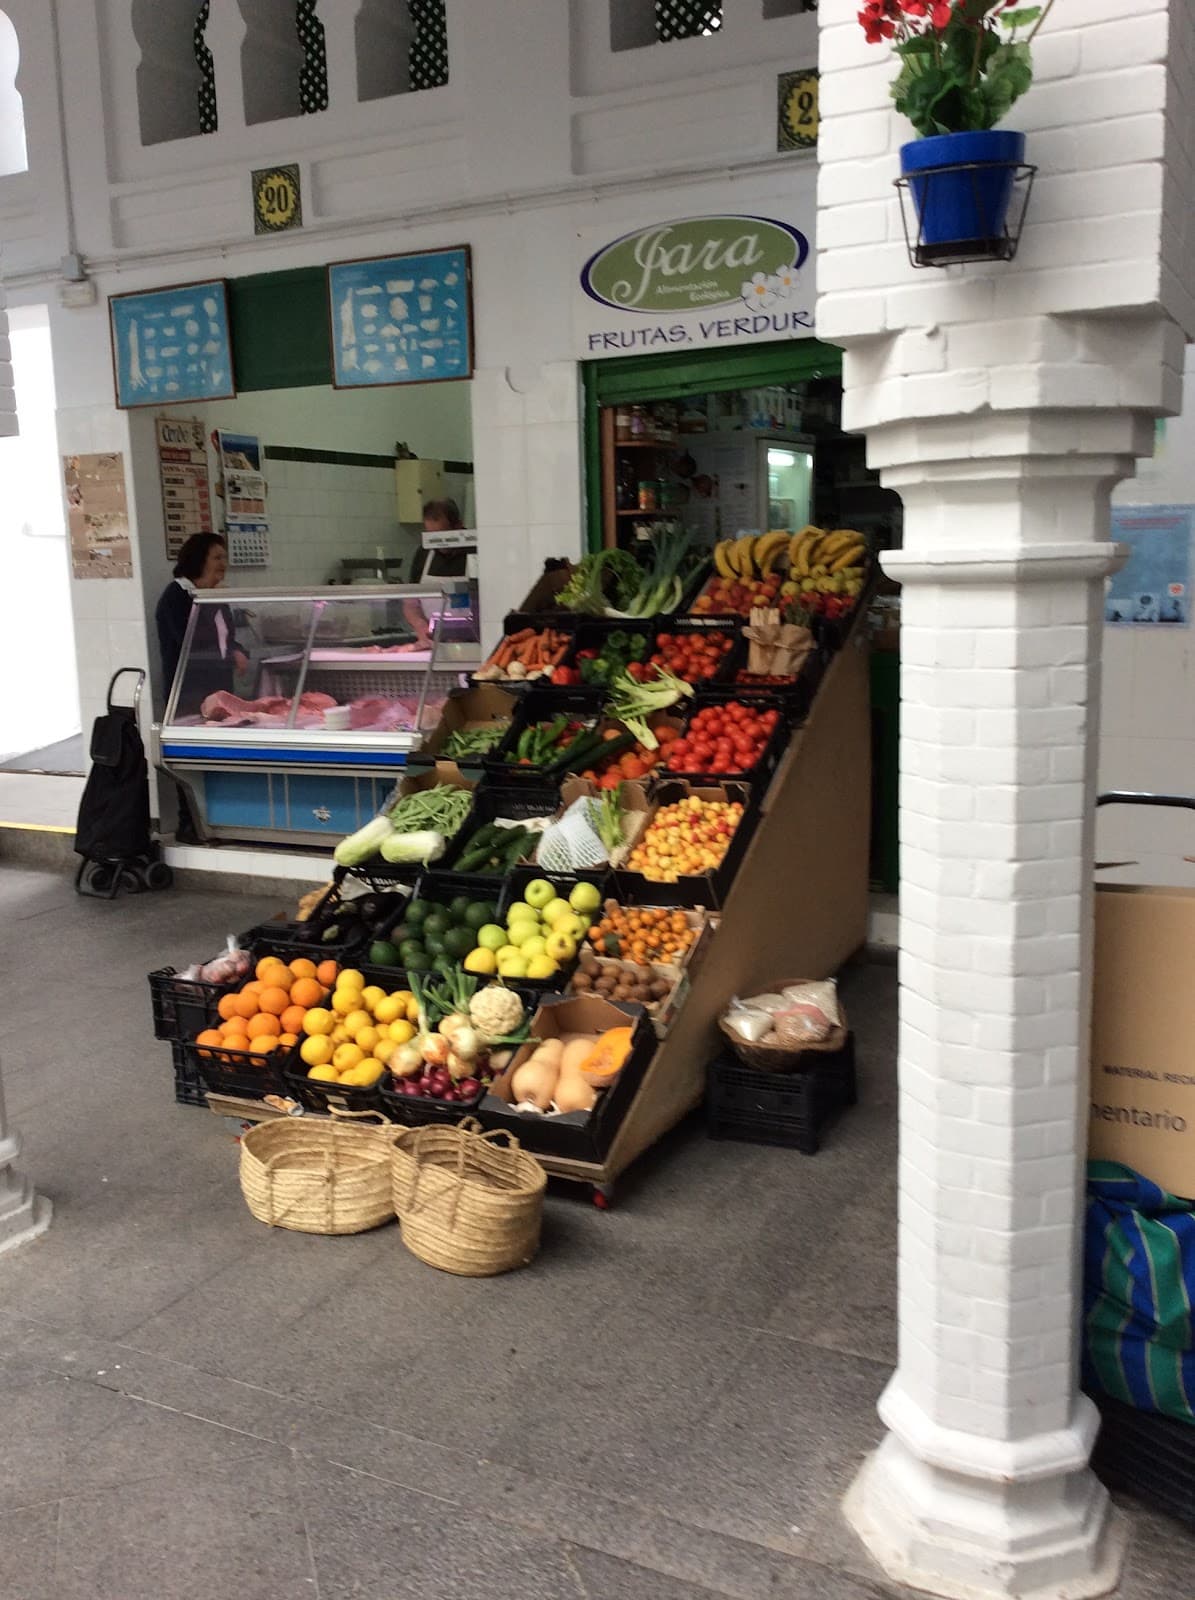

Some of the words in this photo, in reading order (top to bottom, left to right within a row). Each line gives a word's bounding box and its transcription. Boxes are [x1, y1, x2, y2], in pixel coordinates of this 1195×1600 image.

[798, 91, 818, 125] 2
[264, 184, 289, 214] 20
[610, 224, 765, 307] Jara
[587, 324, 693, 351] FRUTAS,
